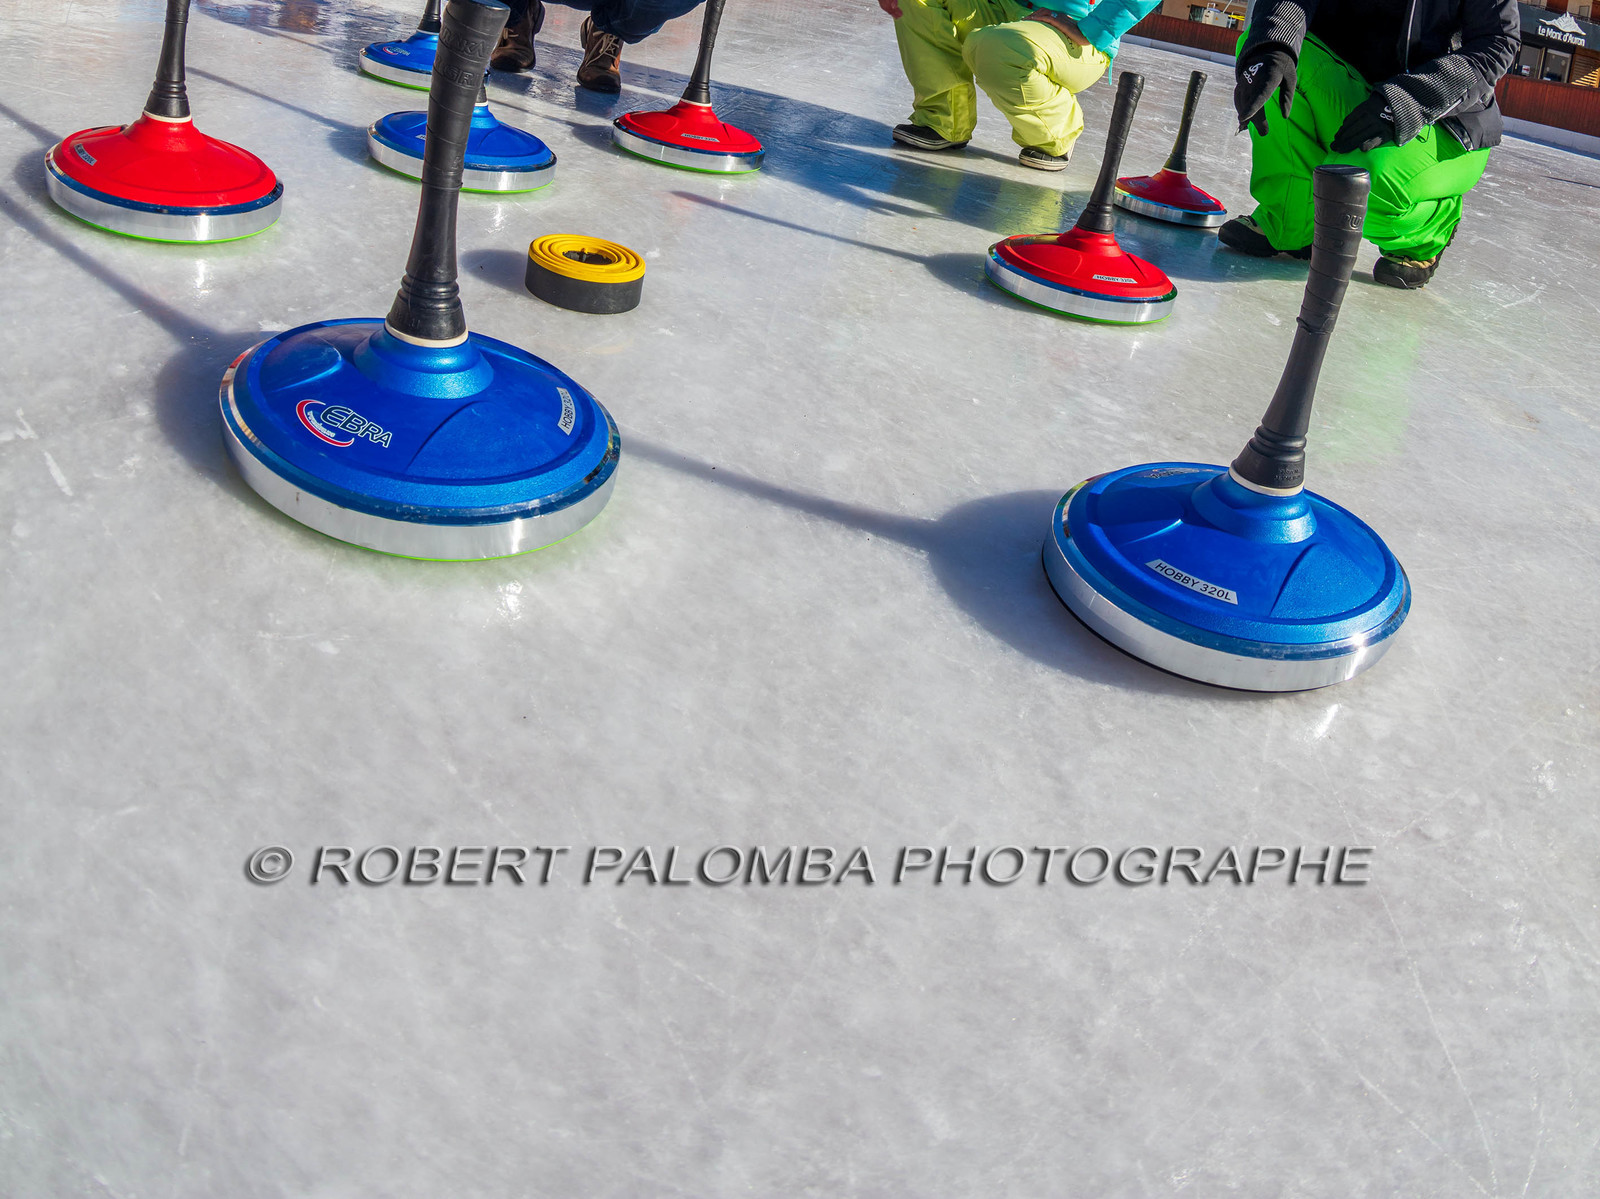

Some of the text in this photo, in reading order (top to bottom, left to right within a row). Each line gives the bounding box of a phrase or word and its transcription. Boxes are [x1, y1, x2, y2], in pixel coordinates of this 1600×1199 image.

[1538, 25, 1586, 46] Le Mont d'Auron
[320, 405, 393, 449] EBRA
[560, 404, 574, 430] HOBBY
[1154, 562, 1231, 601] HOBBY 320L
